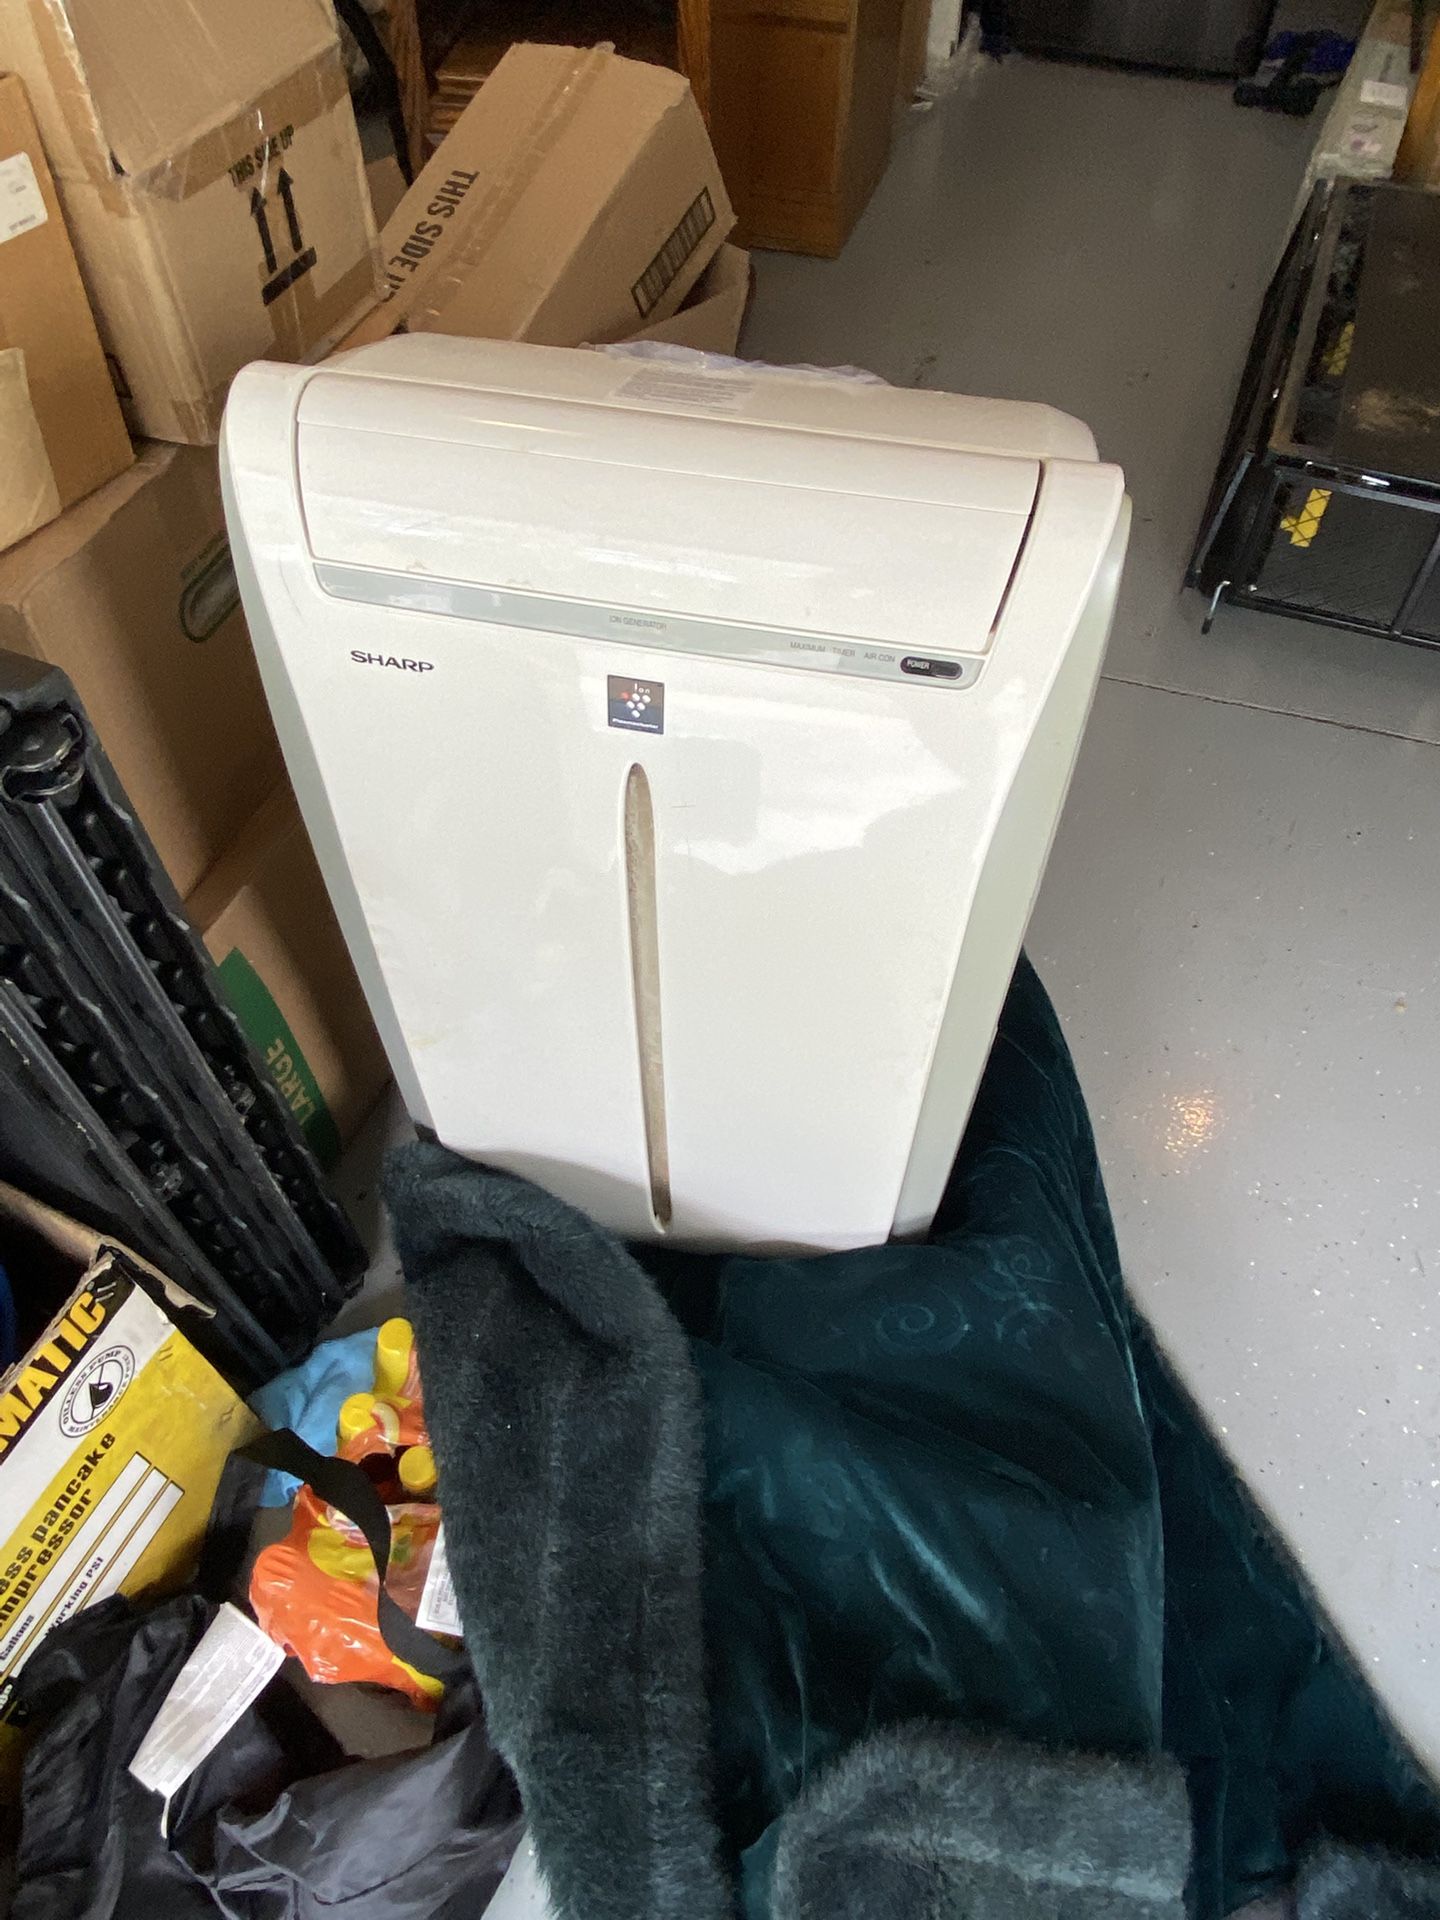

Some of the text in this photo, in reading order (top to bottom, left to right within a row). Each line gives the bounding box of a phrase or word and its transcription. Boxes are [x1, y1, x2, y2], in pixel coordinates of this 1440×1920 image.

[228, 153, 255, 187] THIS
[280, 124, 295, 150] UP
[427, 170, 480, 218] THIS
[388, 221, 443, 273] SIDE
[609, 615, 667, 631] ION GENERATOR
[350, 650, 435, 673] SHARP
[790, 641, 930, 670] MAXIMUM TIMER AIR CON POWER
[264, 1038, 316, 1126] LARGE
[31, 1432, 116, 1544] pancake
[0, 1488, 92, 1627] mpressor
[86, 1556, 104, 1578] PSI
